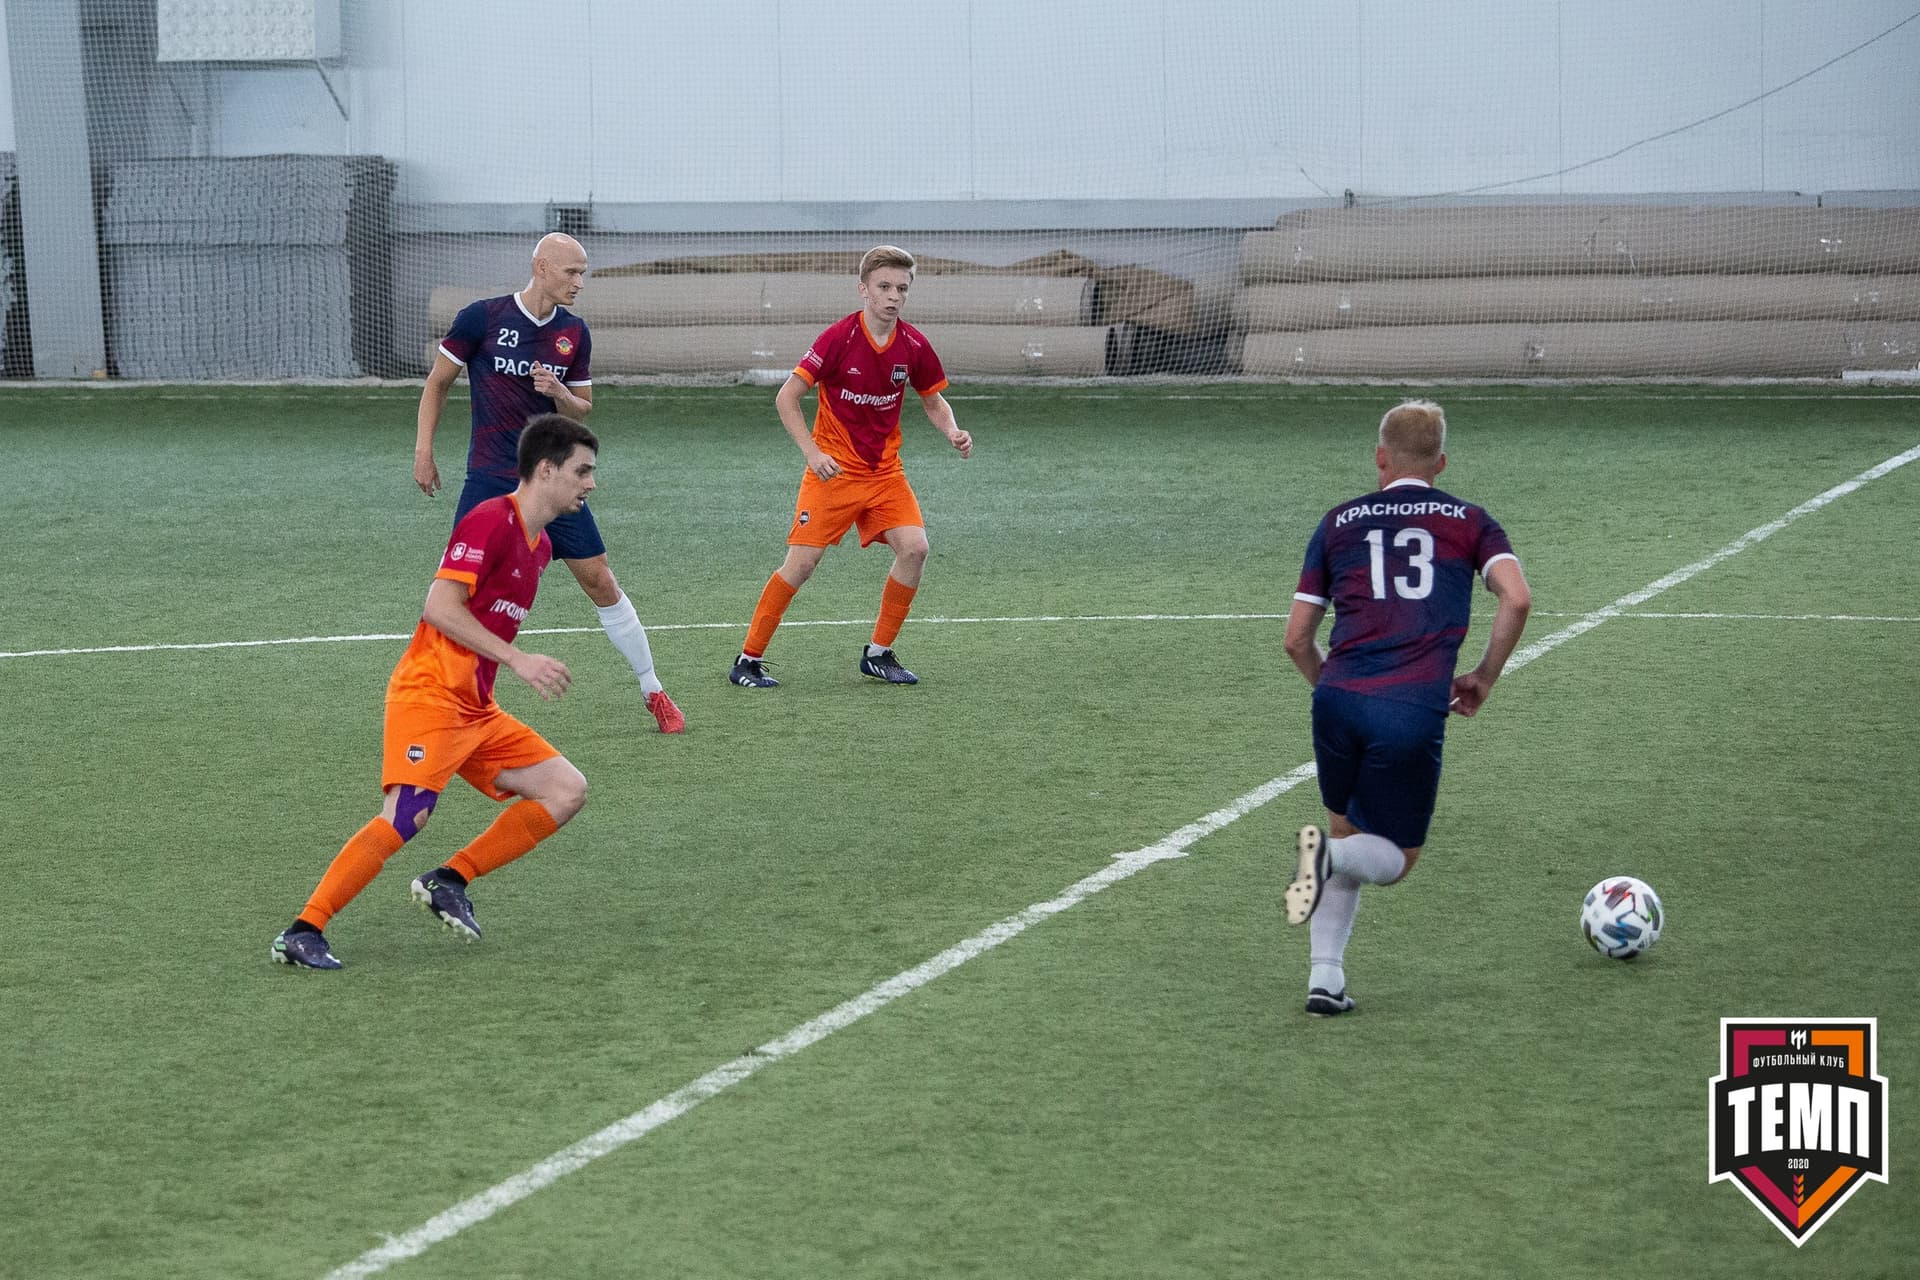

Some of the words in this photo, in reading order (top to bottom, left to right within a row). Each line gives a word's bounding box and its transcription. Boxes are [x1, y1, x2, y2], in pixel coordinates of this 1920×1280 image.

[497, 328, 519, 348] 23
[1335, 502, 1466, 528] КРАСНОЯРСК
[1362, 527, 1434, 600] 13
